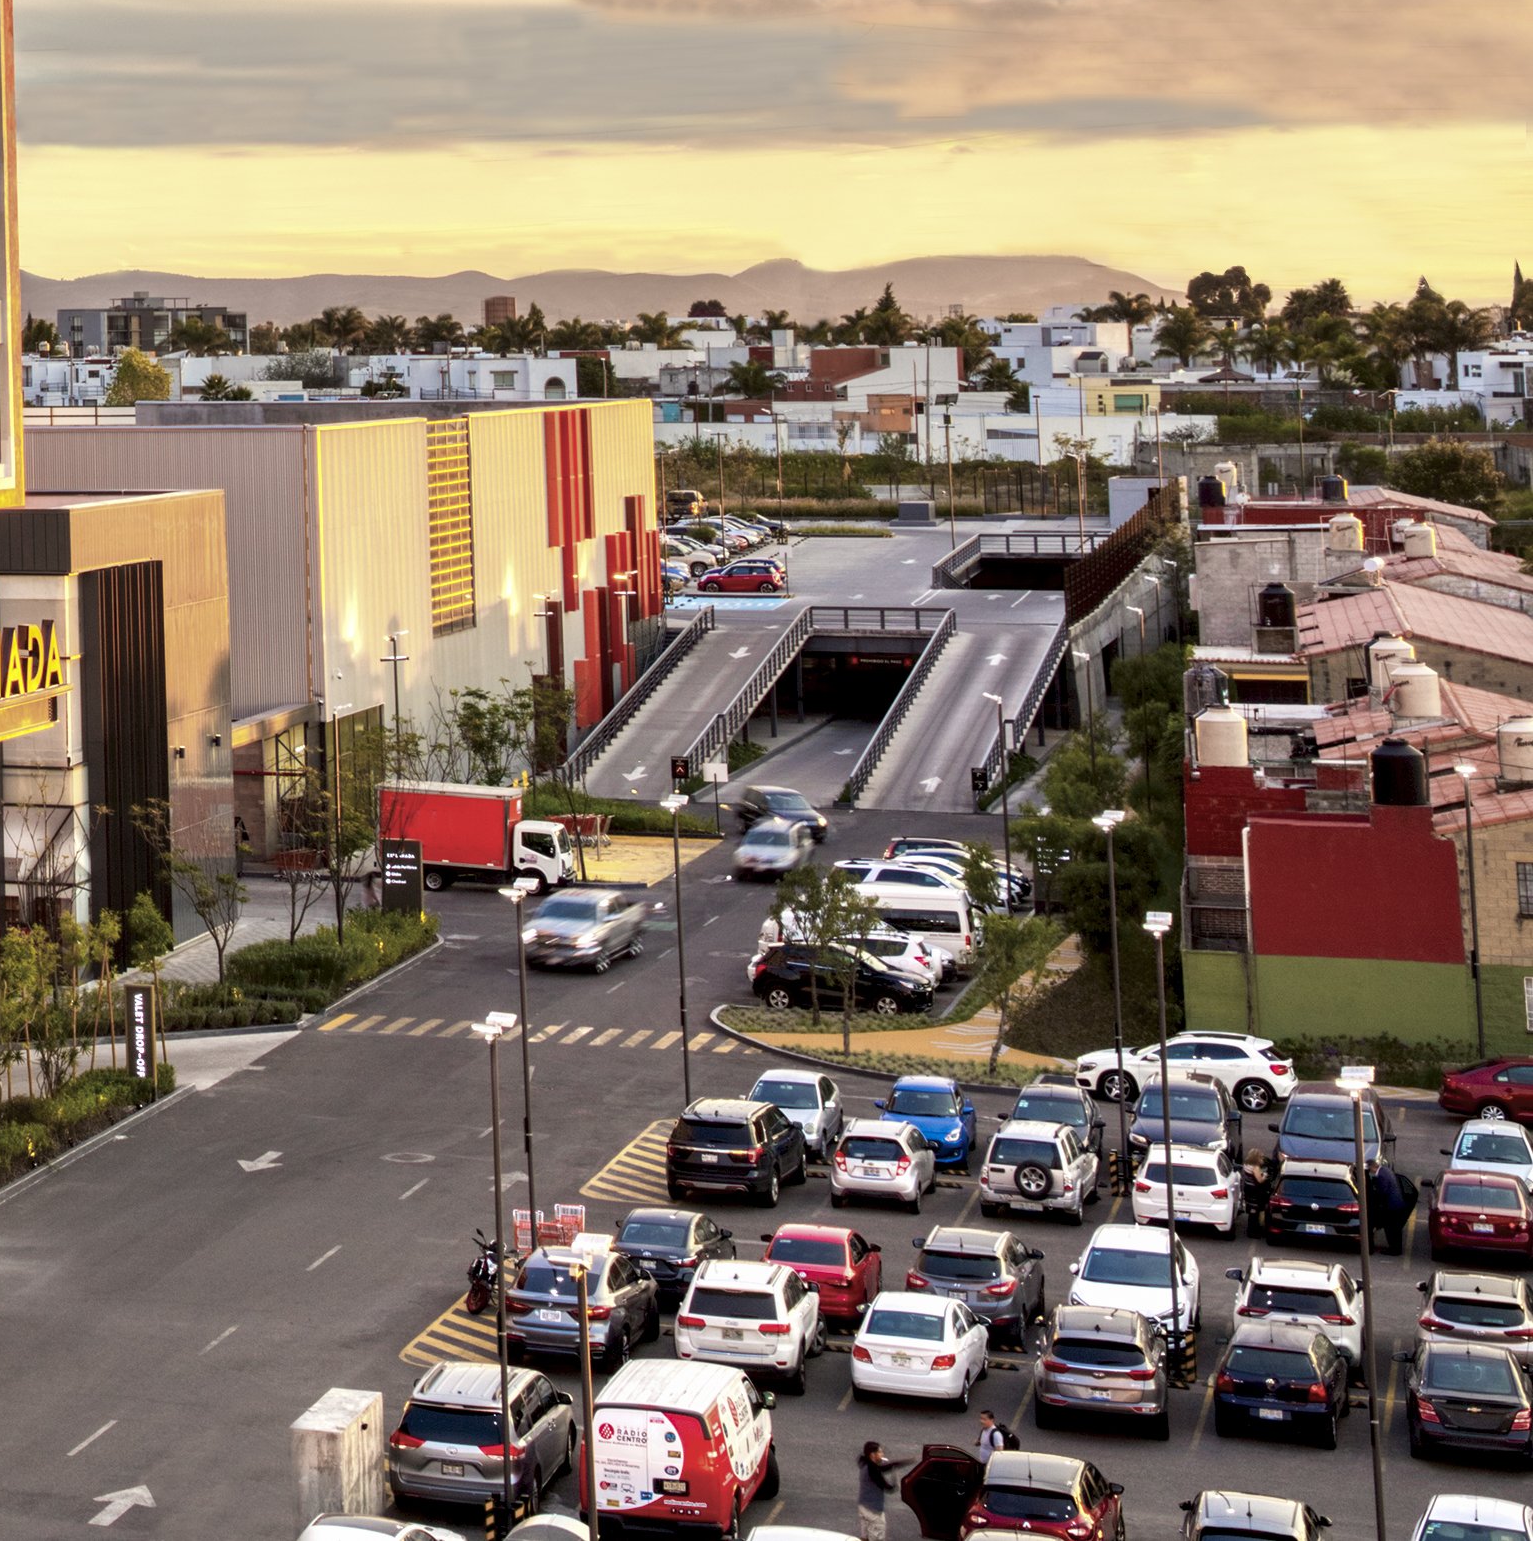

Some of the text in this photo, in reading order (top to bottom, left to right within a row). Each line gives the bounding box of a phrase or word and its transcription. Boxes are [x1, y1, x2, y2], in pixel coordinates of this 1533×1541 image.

[133, 993, 146, 1078] VALET DROP-OFF
[616, 1428, 647, 1438] RADIO
[616, 1435, 647, 1444] CENTRO
